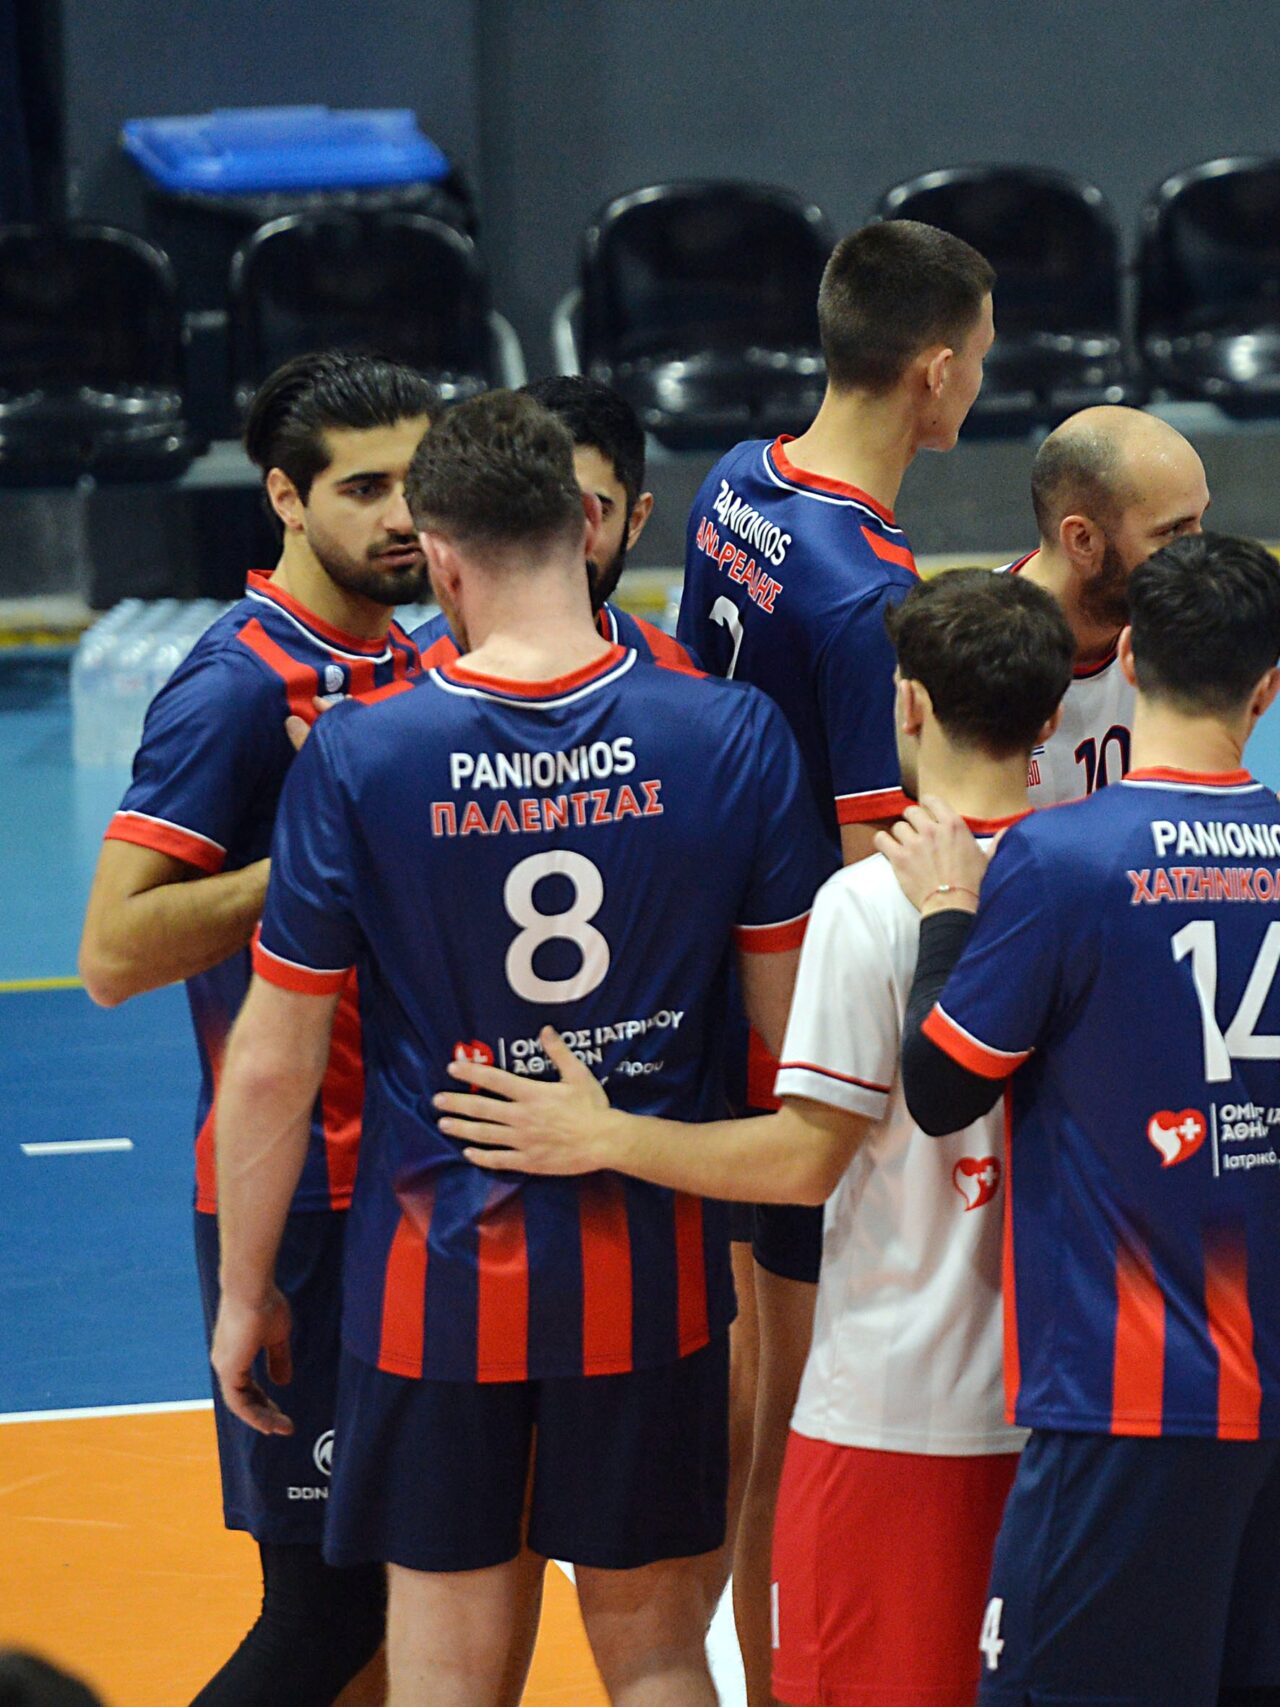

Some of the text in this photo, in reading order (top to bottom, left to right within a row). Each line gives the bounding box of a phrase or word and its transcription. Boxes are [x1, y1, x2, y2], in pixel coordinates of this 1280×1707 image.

[451, 736, 636, 789] PANIONIOS
[1074, 725, 1132, 796] 10
[430, 780, 664, 837] ΠΑΛΕΝΤΖΑΣ
[504, 850, 610, 1004] 8
[979, 1597, 1005, 1670] 4
